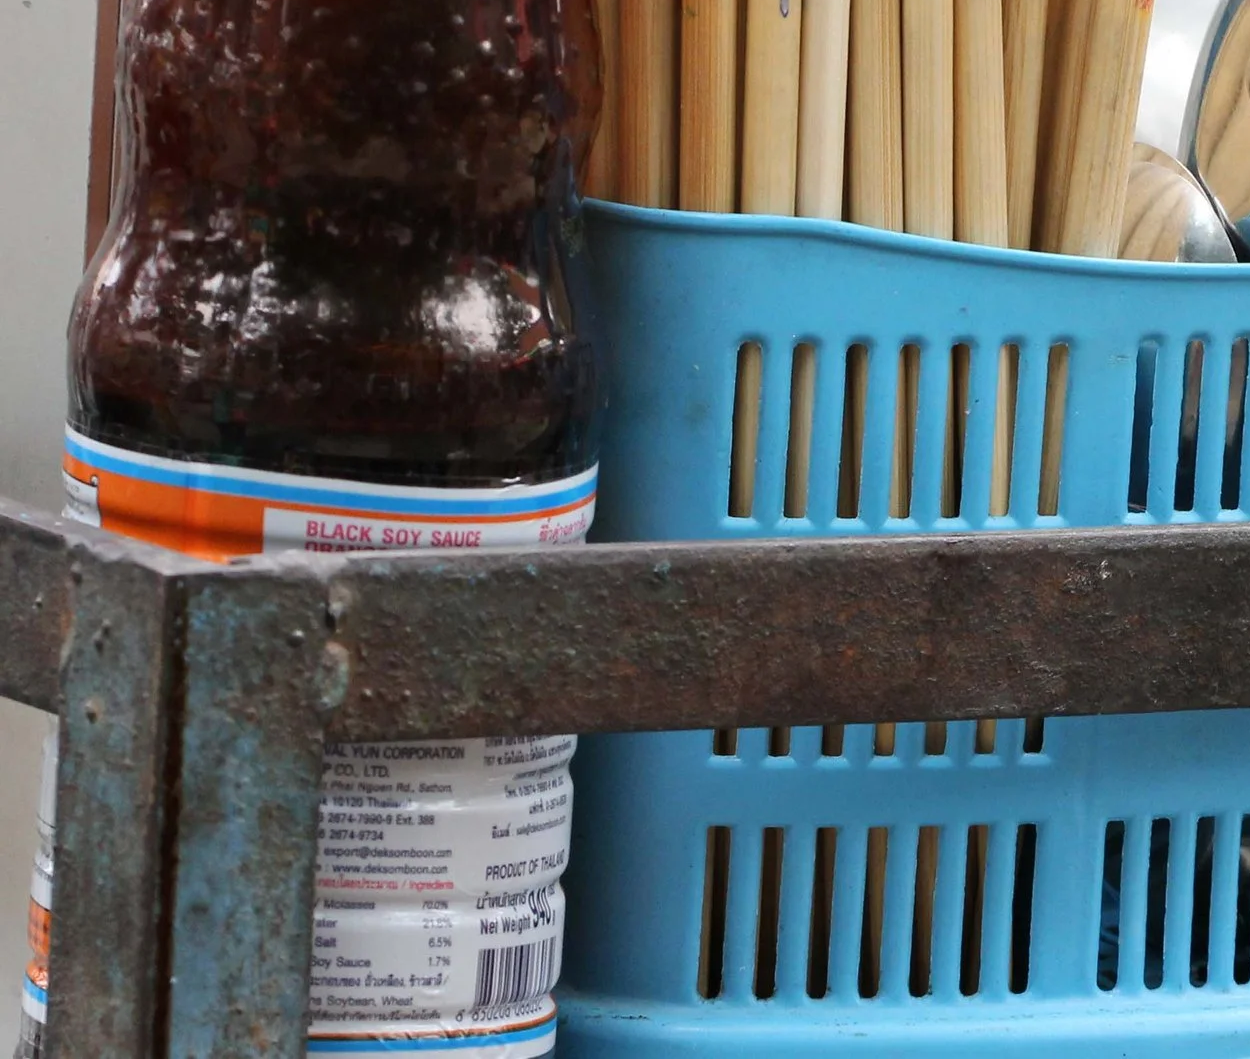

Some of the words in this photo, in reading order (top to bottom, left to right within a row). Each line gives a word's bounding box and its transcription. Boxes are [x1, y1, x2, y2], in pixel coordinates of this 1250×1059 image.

[306, 520, 372, 542] BLACK
[382, 527, 422, 547] SOY
[431, 530, 482, 548] SAUCE
[351, 744, 380, 759] YUN
[383, 746, 465, 760] CORPORATION
[363, 764, 390, 778] LTD.
[486, 861, 527, 881] PRODUCT
[528, 858, 539, 875] OF
[315, 919, 337, 928] ater
[480, 917, 499, 936] Net
[502, 915, 531, 935] Weight
[315, 936, 337, 948] Salt
[336, 956, 371, 967] Sauce
[382, 995, 413, 1006] Wheat
